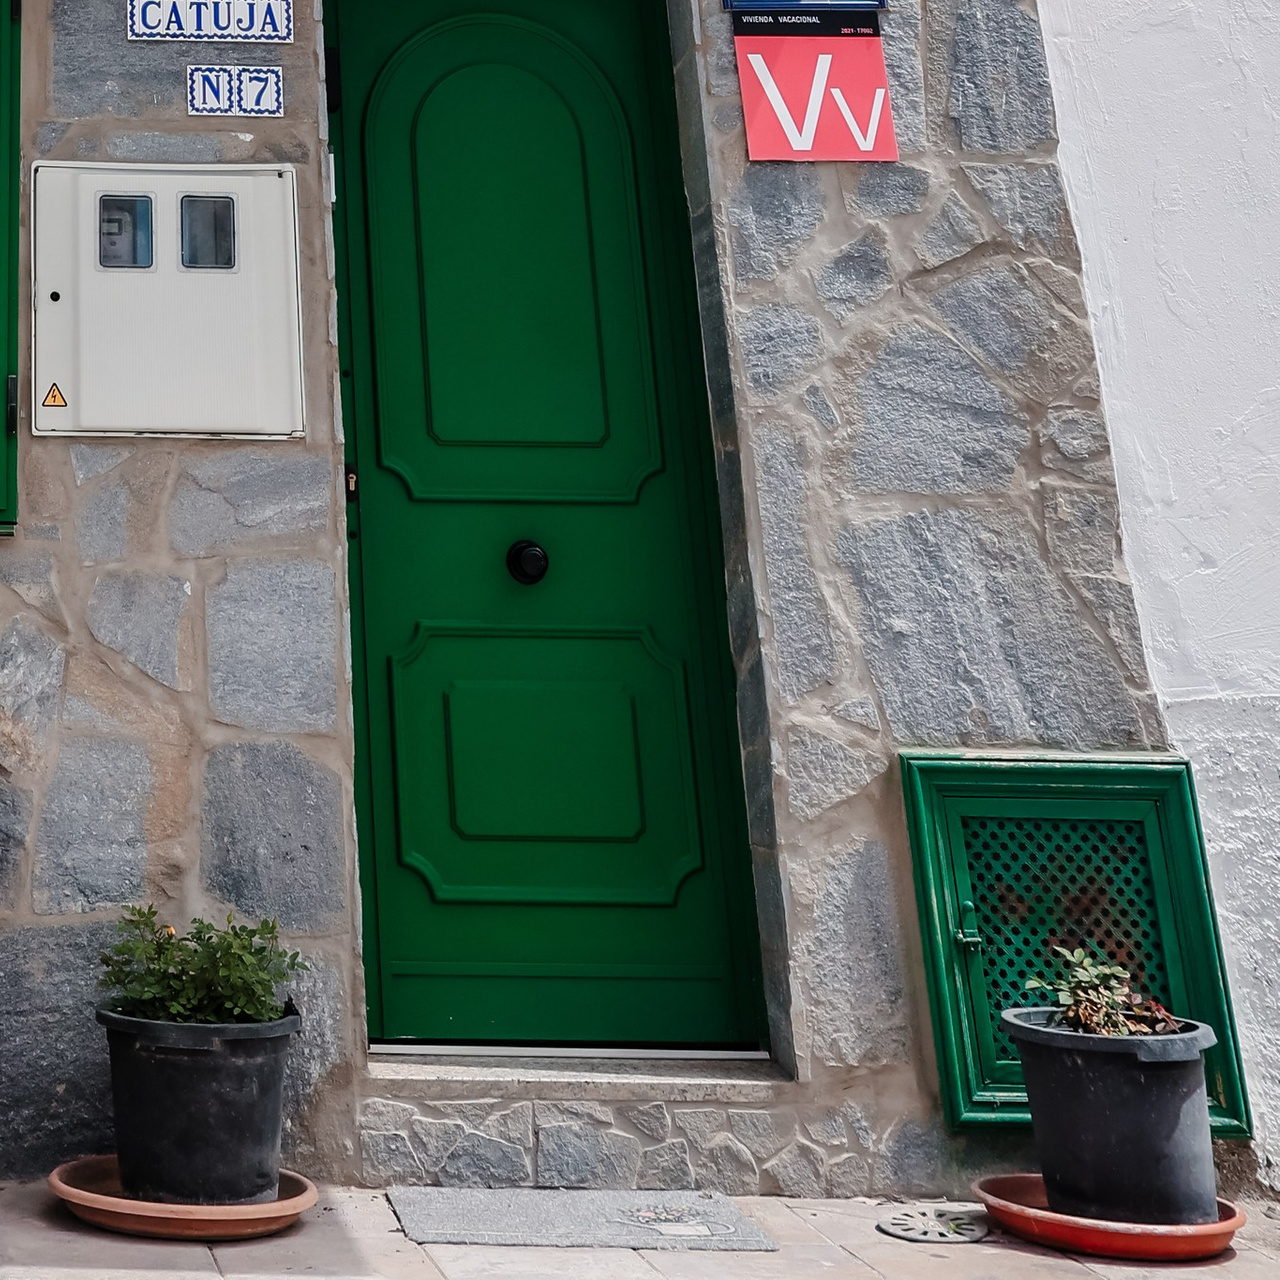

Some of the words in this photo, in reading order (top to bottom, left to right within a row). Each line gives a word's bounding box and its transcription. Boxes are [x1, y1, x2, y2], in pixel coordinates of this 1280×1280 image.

[140, 0, 280, 33] CATUJA
[742, 15, 774, 23] VIVIENDA
[201, 74, 221, 106] N
[248, 75, 269, 106] 7
